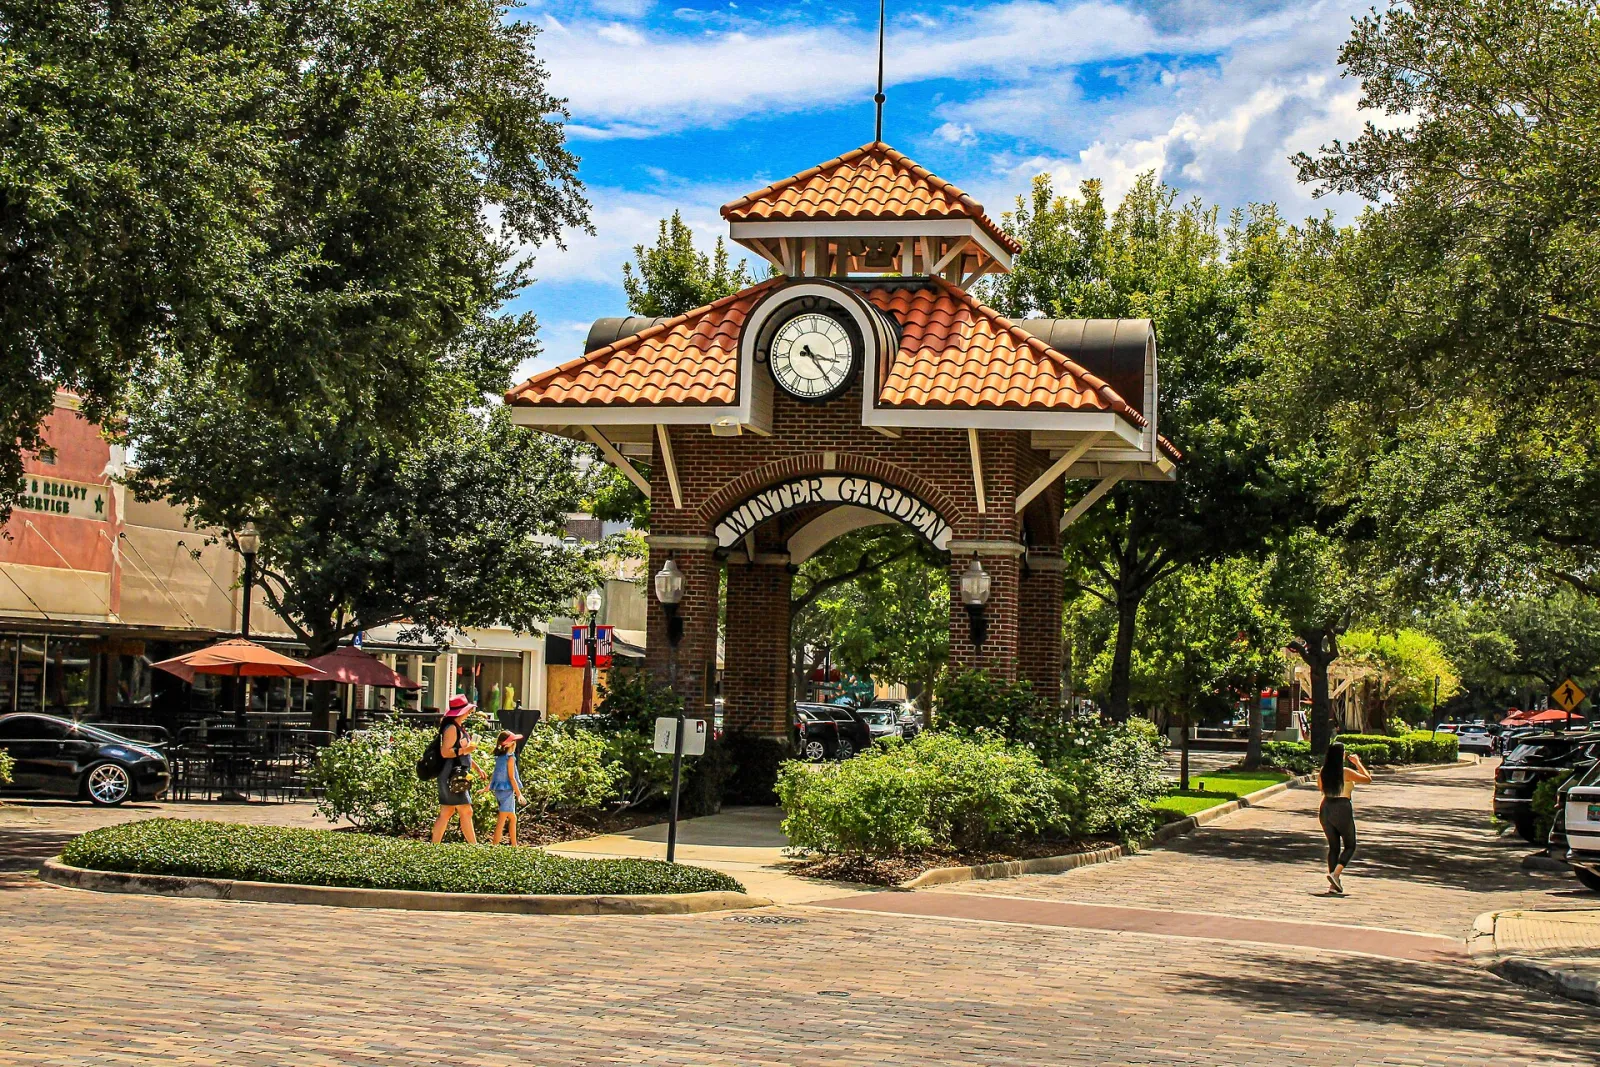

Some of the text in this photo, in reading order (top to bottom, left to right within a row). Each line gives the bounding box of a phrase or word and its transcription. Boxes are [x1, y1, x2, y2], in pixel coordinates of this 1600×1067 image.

[43, 482, 87, 500] REALTY
[21, 495, 69, 514] ERVICE
[724, 478, 948, 541] WINTER GARDEN
